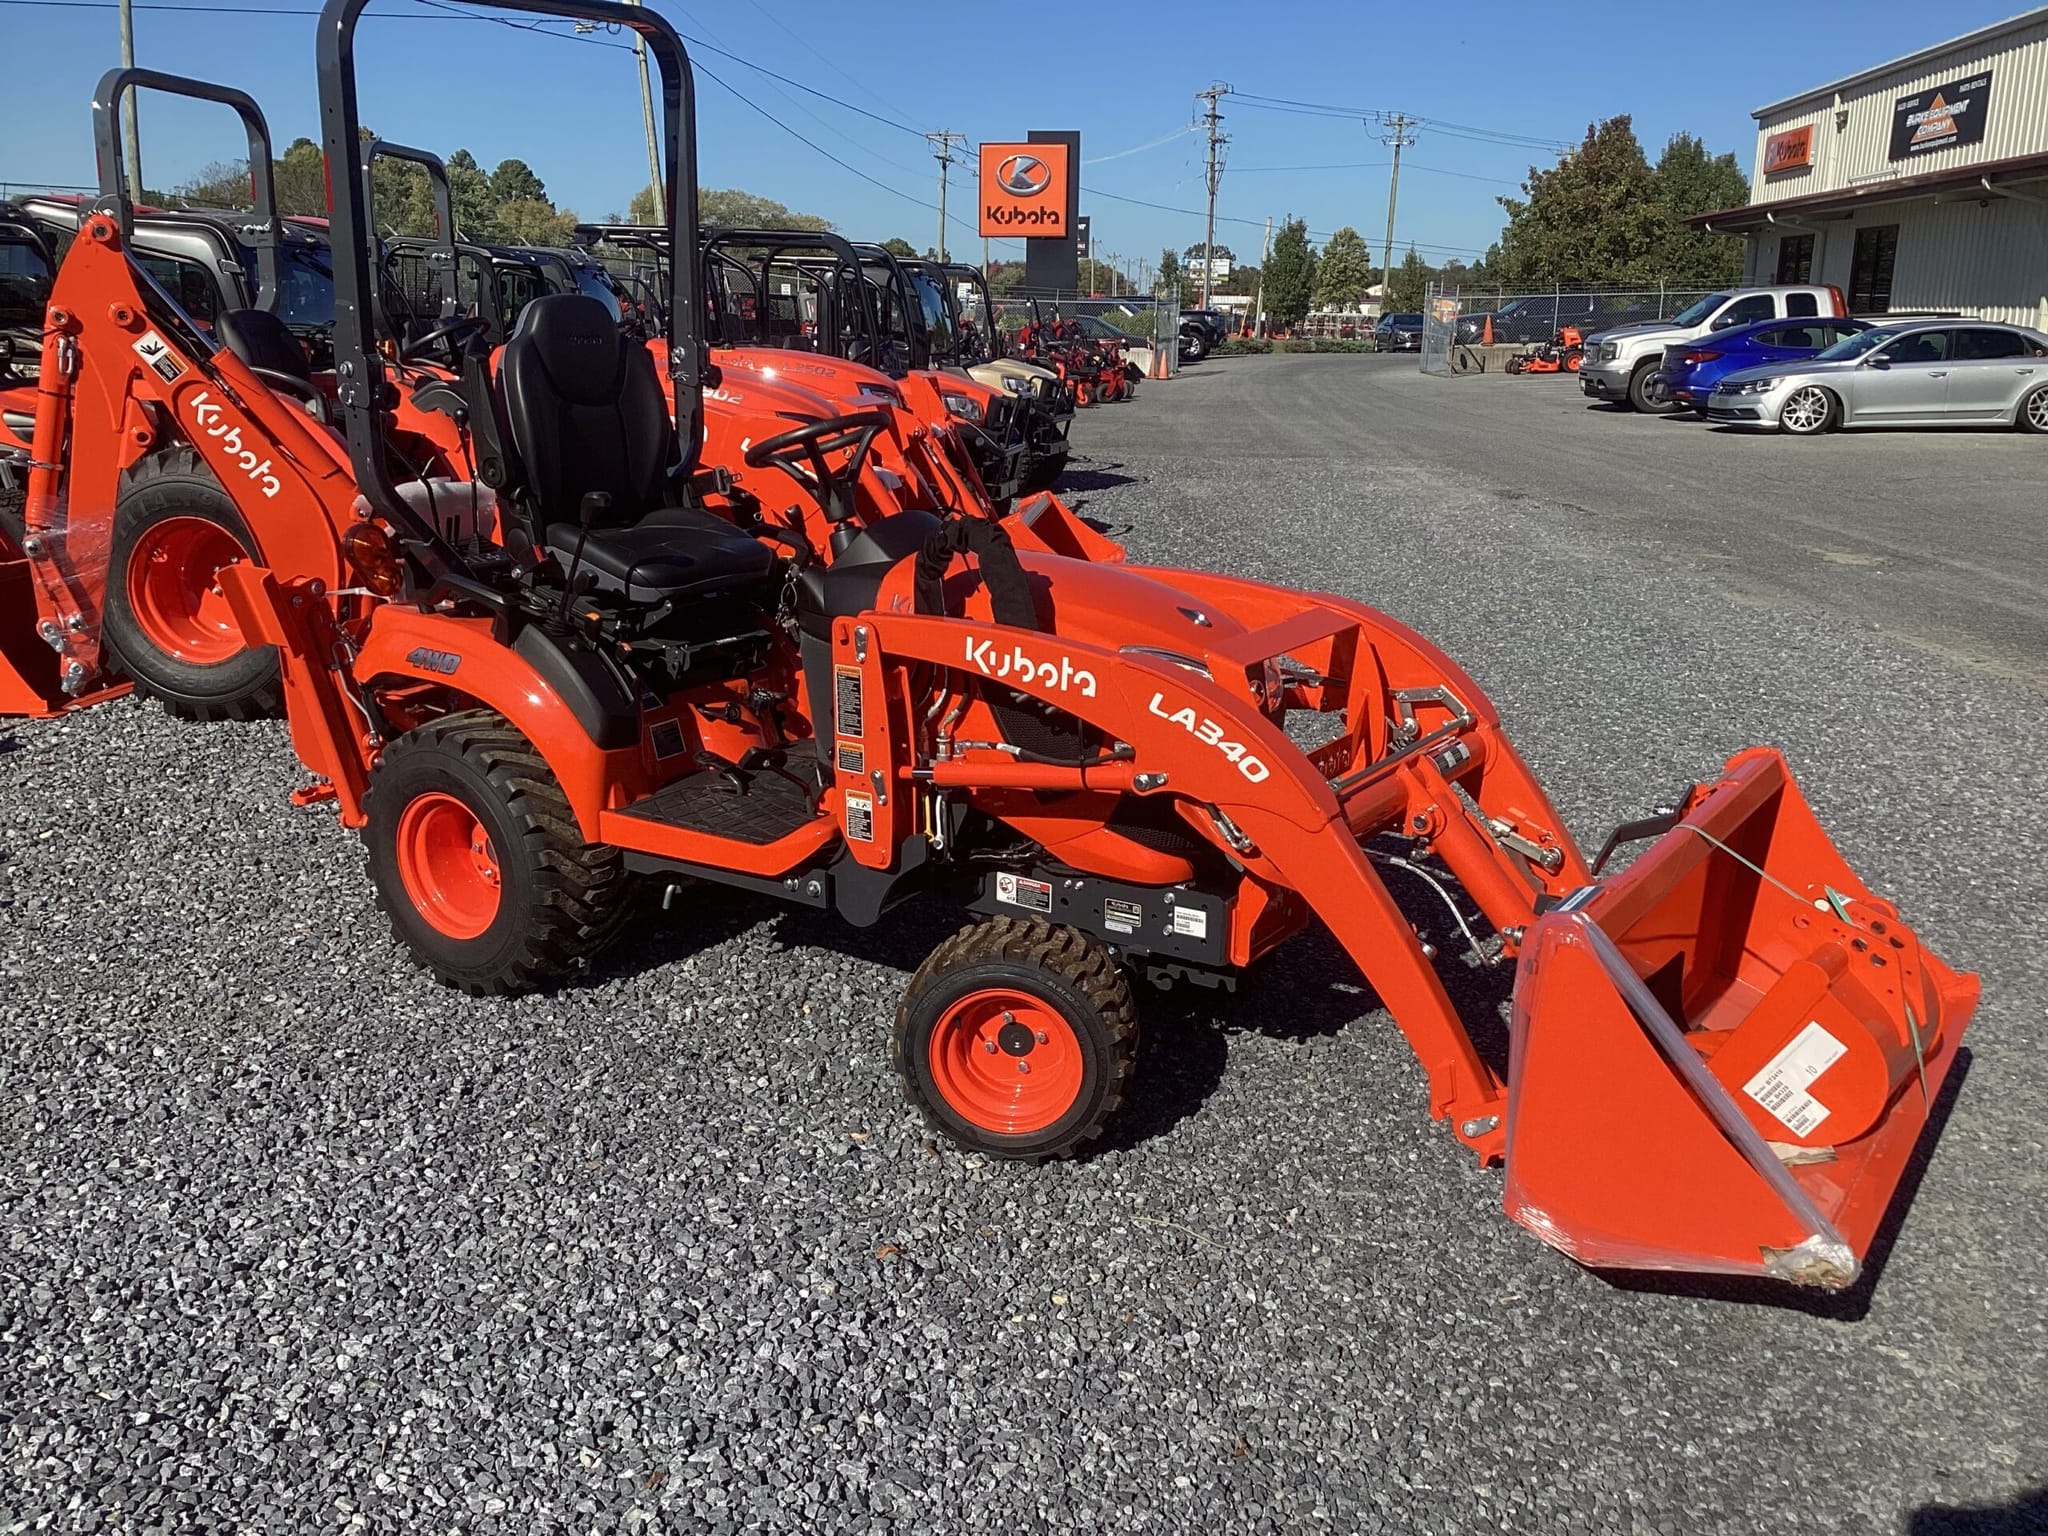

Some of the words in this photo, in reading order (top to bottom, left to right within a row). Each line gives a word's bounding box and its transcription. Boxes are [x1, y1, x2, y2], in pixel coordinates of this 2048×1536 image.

[1906, 110, 1931, 127] BURKE
[1929, 98, 1970, 120] EQUIPMENT
[1776, 136, 1806, 162] Kubota
[987, 205, 1060, 225] Kubota
[190, 391, 281, 498] Kubota
[406, 647, 462, 675] 4WD
[965, 635, 1097, 699] Kubota
[1149, 692, 1270, 784] LA340
